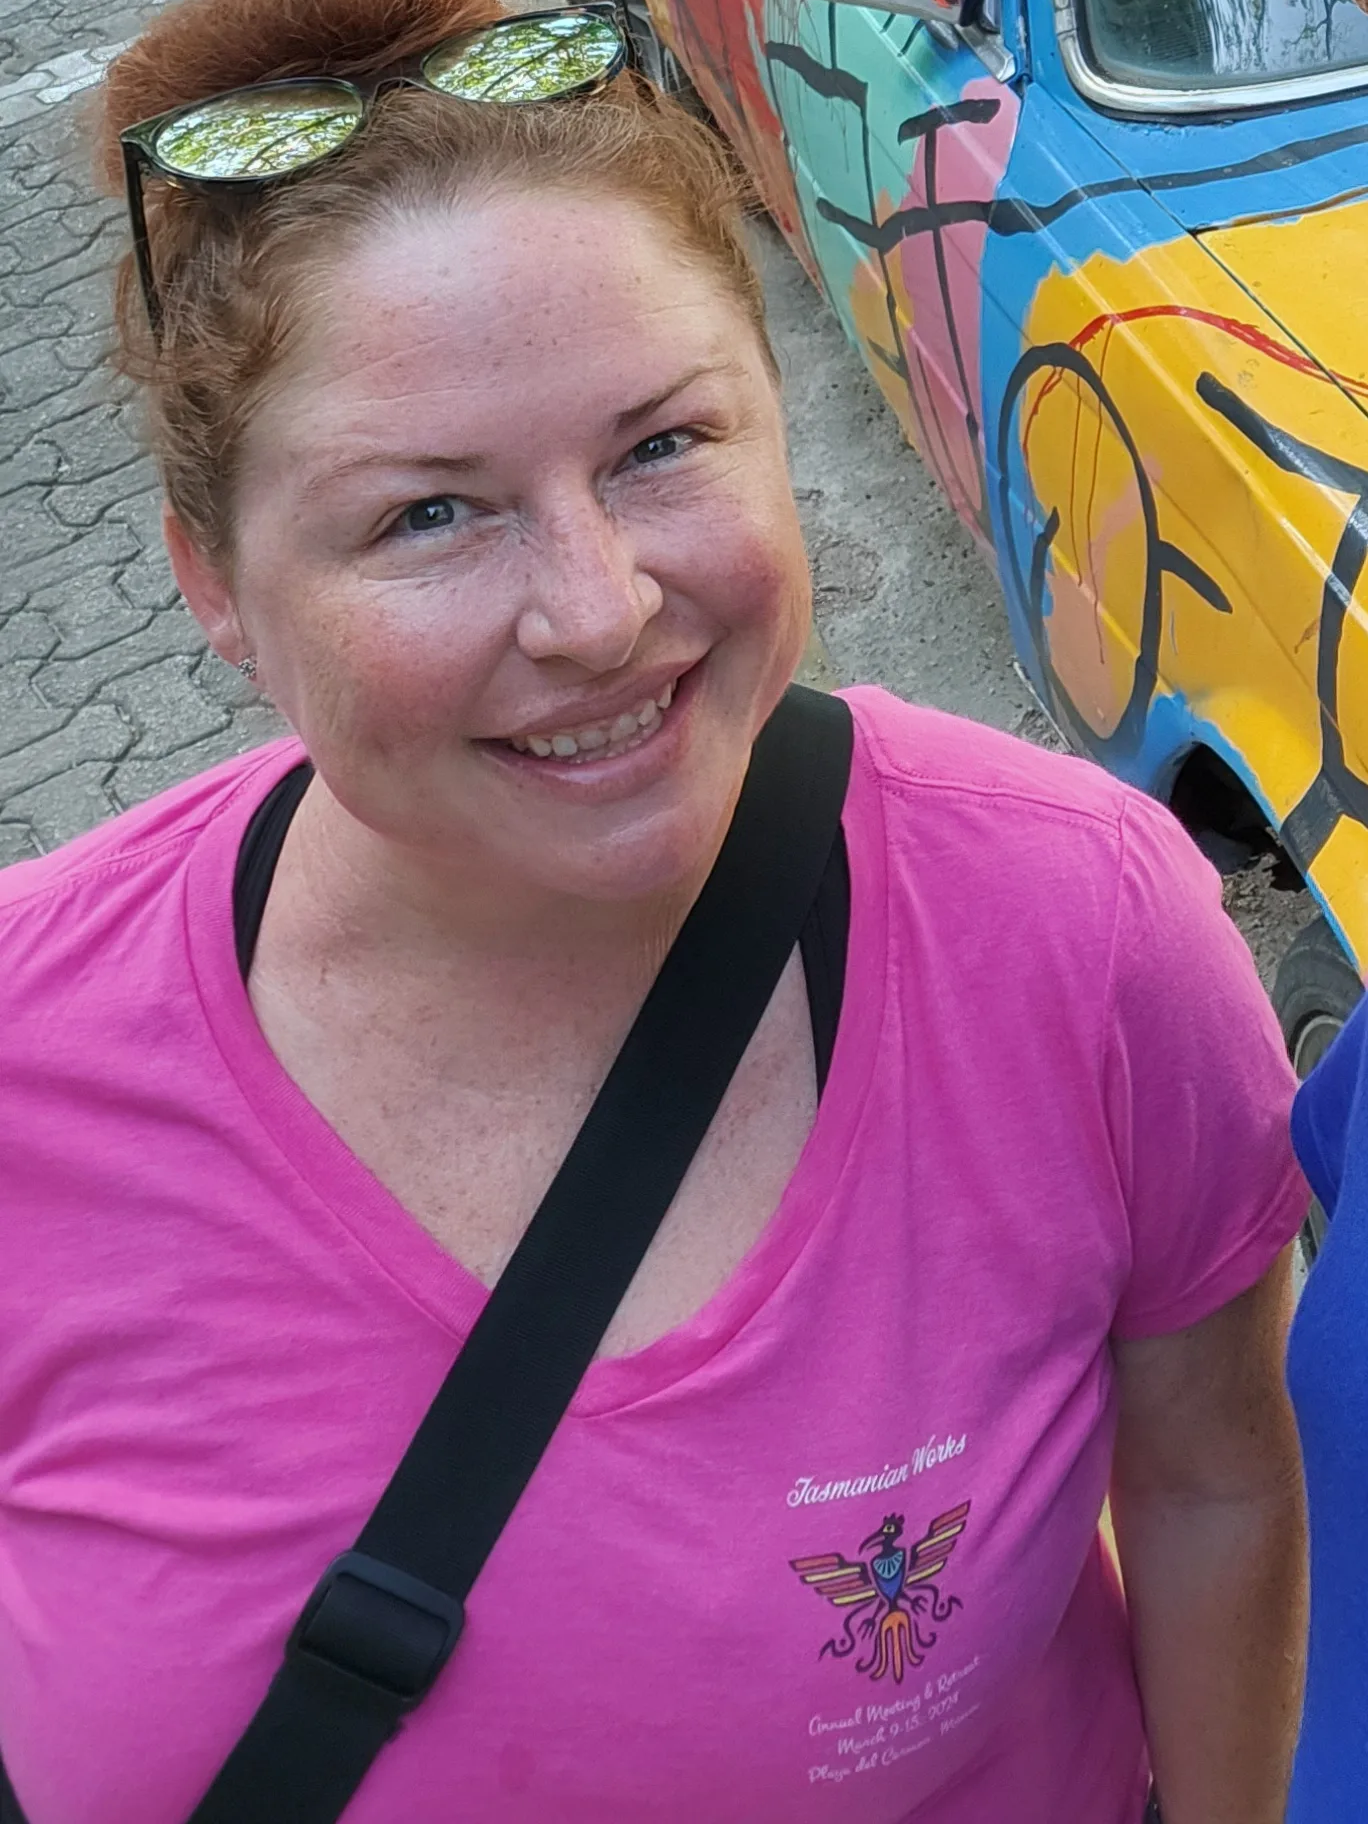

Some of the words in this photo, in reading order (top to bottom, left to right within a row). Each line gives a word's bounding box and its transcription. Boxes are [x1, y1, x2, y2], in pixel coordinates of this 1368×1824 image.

[786, 1463, 908, 1508] Tasmanian
[911, 1433, 967, 1475] Works
[808, 1707, 863, 1736] Annual
[866, 1695, 921, 1723] Meeting
[838, 1726, 887, 1755] March
[808, 1764, 851, 1783] Playa
